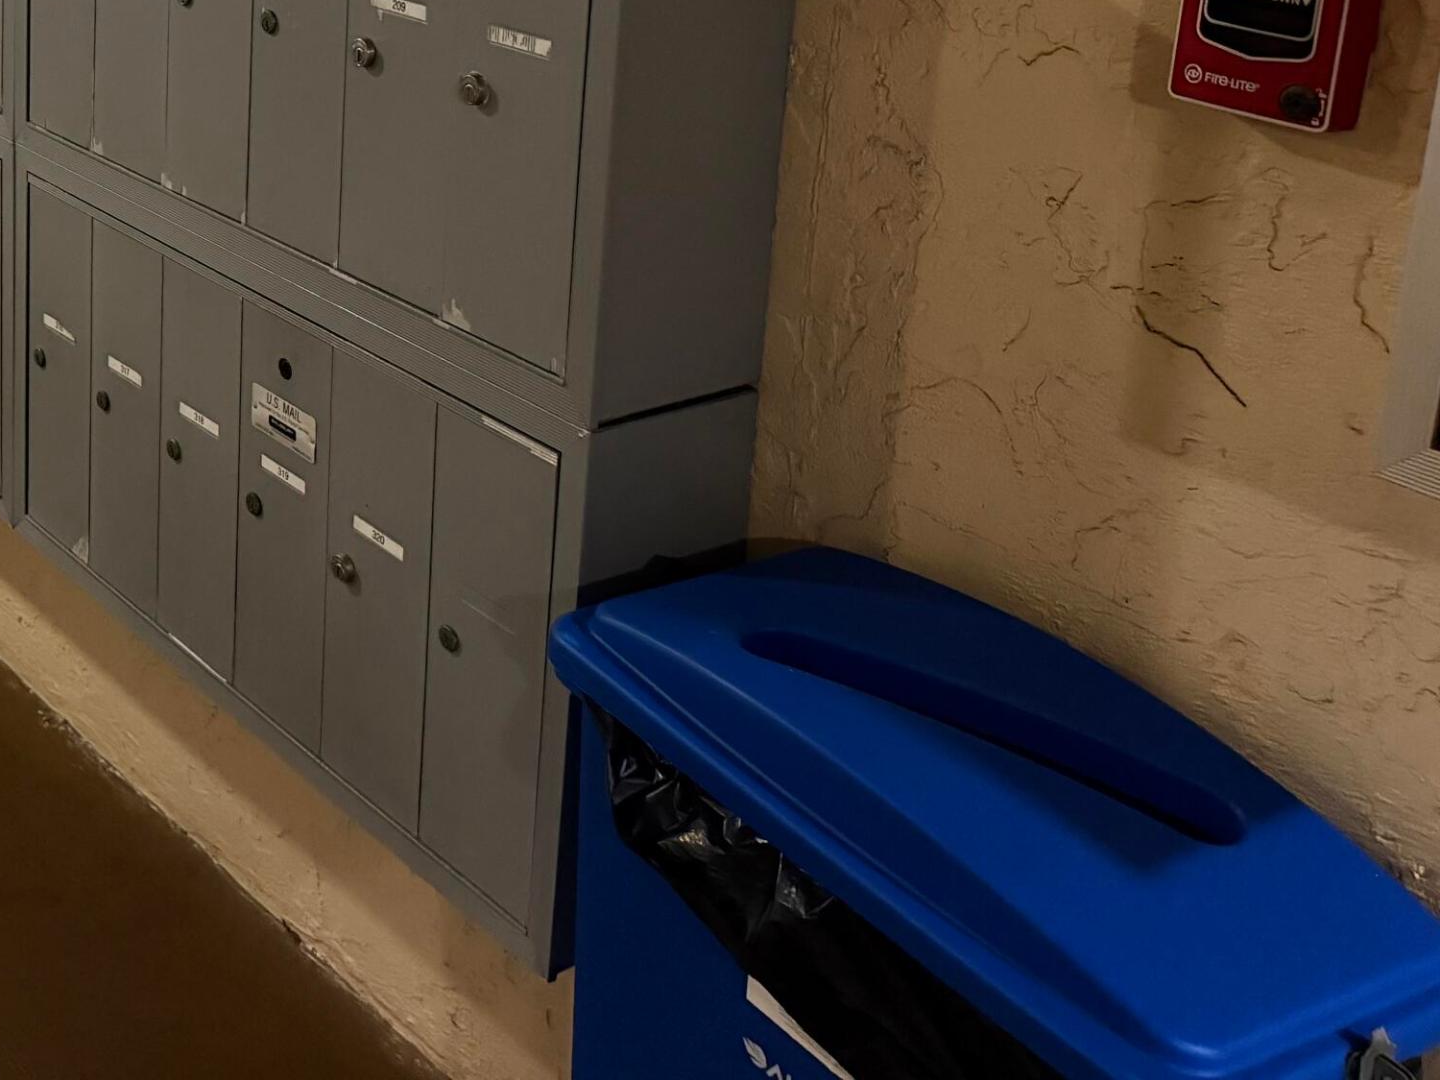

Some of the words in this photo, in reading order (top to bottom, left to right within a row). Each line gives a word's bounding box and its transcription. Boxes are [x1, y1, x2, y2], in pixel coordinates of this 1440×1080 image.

[391, 0, 407, 13] 209
[266, 392, 280, 410] U.S.
[282, 402, 302, 424] MAIL
[372, 529, 385, 546] 320
